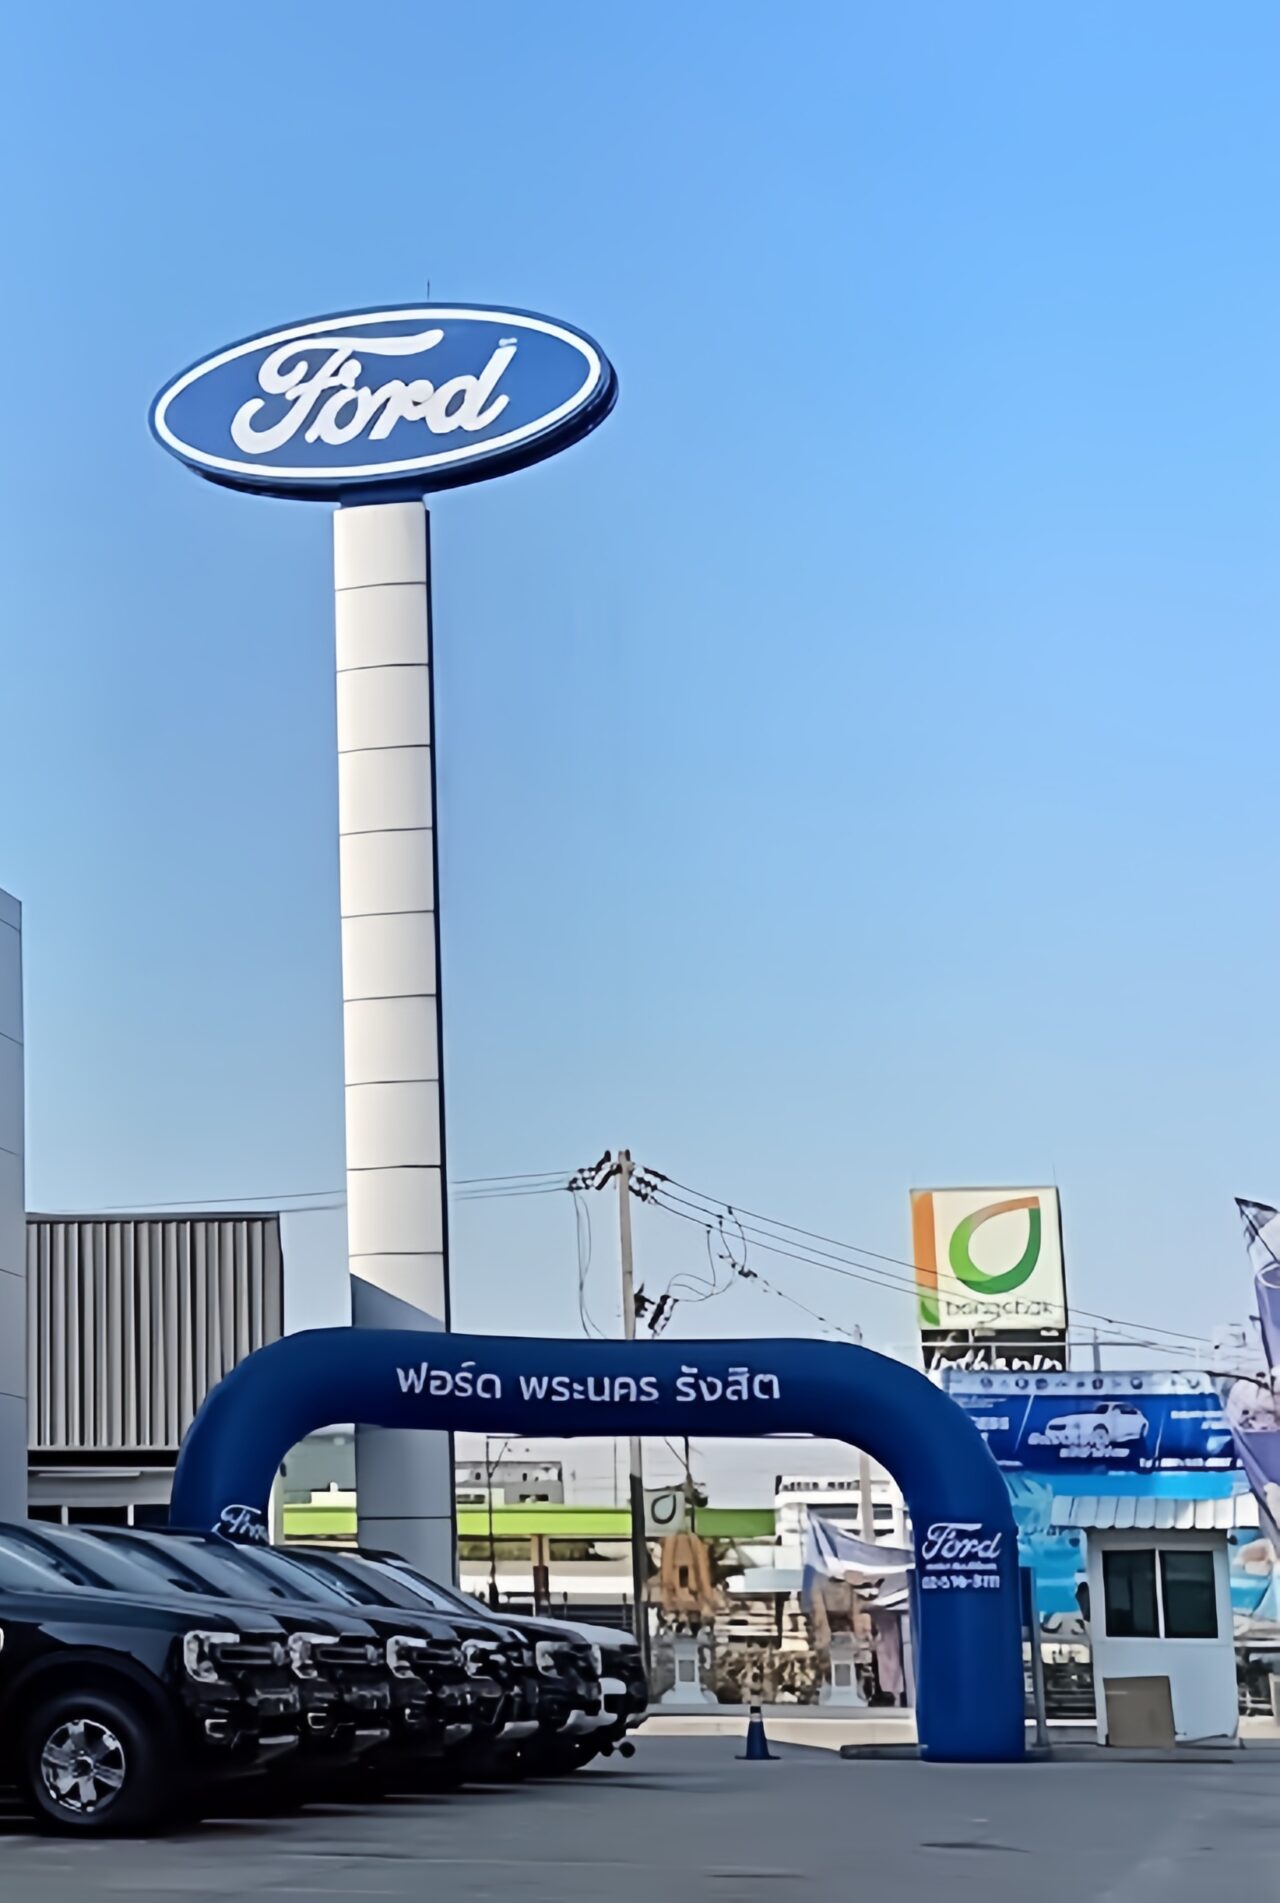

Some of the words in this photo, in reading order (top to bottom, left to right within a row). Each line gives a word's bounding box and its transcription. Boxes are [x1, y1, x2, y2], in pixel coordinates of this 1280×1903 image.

[230, 328, 518, 454] Ford
[396, 1361, 502, 1399] ฟอร์ด
[520, 1375, 659, 1402] พระนคร
[675, 1364, 781, 1402] รังสิต
[921, 1522, 1002, 1560] Ford
